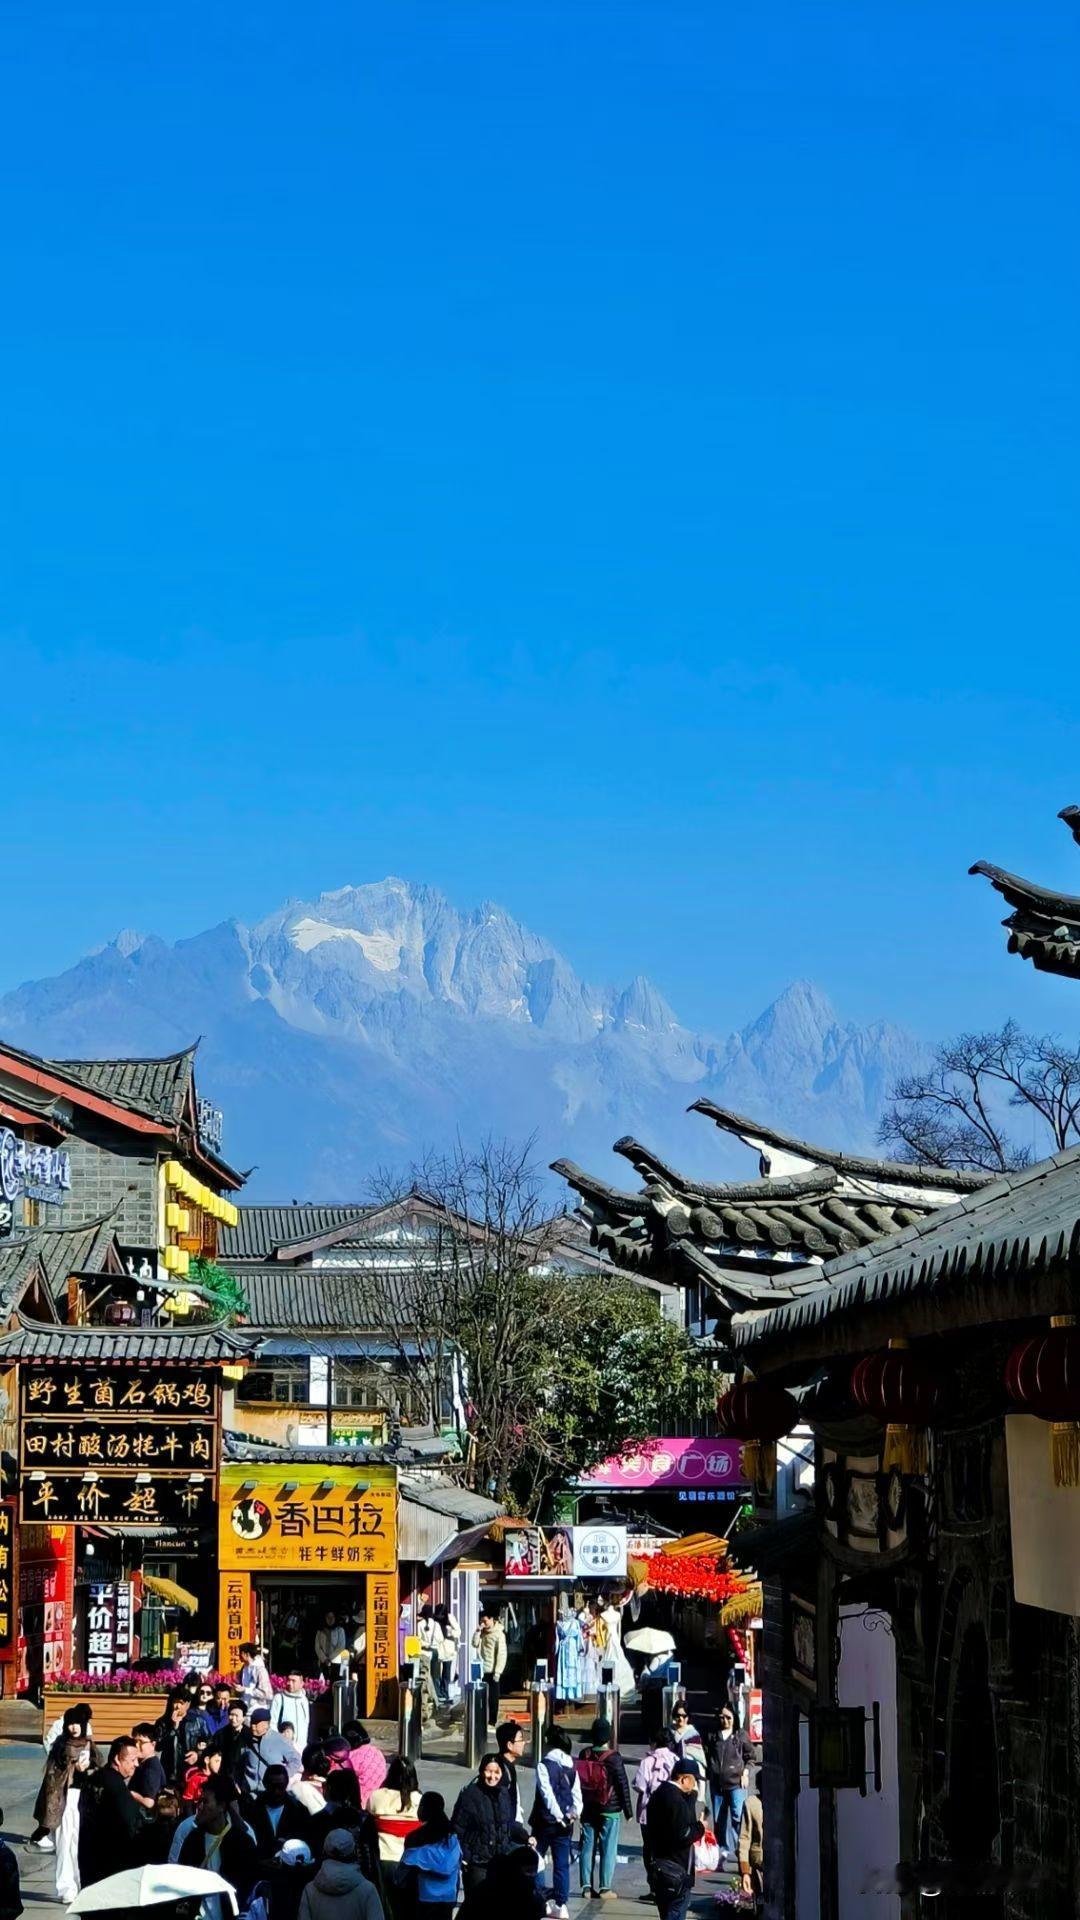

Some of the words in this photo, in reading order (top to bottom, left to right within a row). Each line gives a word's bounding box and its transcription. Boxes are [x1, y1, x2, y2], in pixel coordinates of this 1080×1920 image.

[26, 1431, 210, 1461] 田村酸汤牦牛肉
[32, 1482, 204, 1518] 平价超市
[275, 1501, 387, 1539] 香巴拉
[299, 1546, 376, 1562] 牦牛鲜奶茶
[227, 1580, 243, 1640] 云南首创
[88, 1583, 113, 1677] 平价超市
